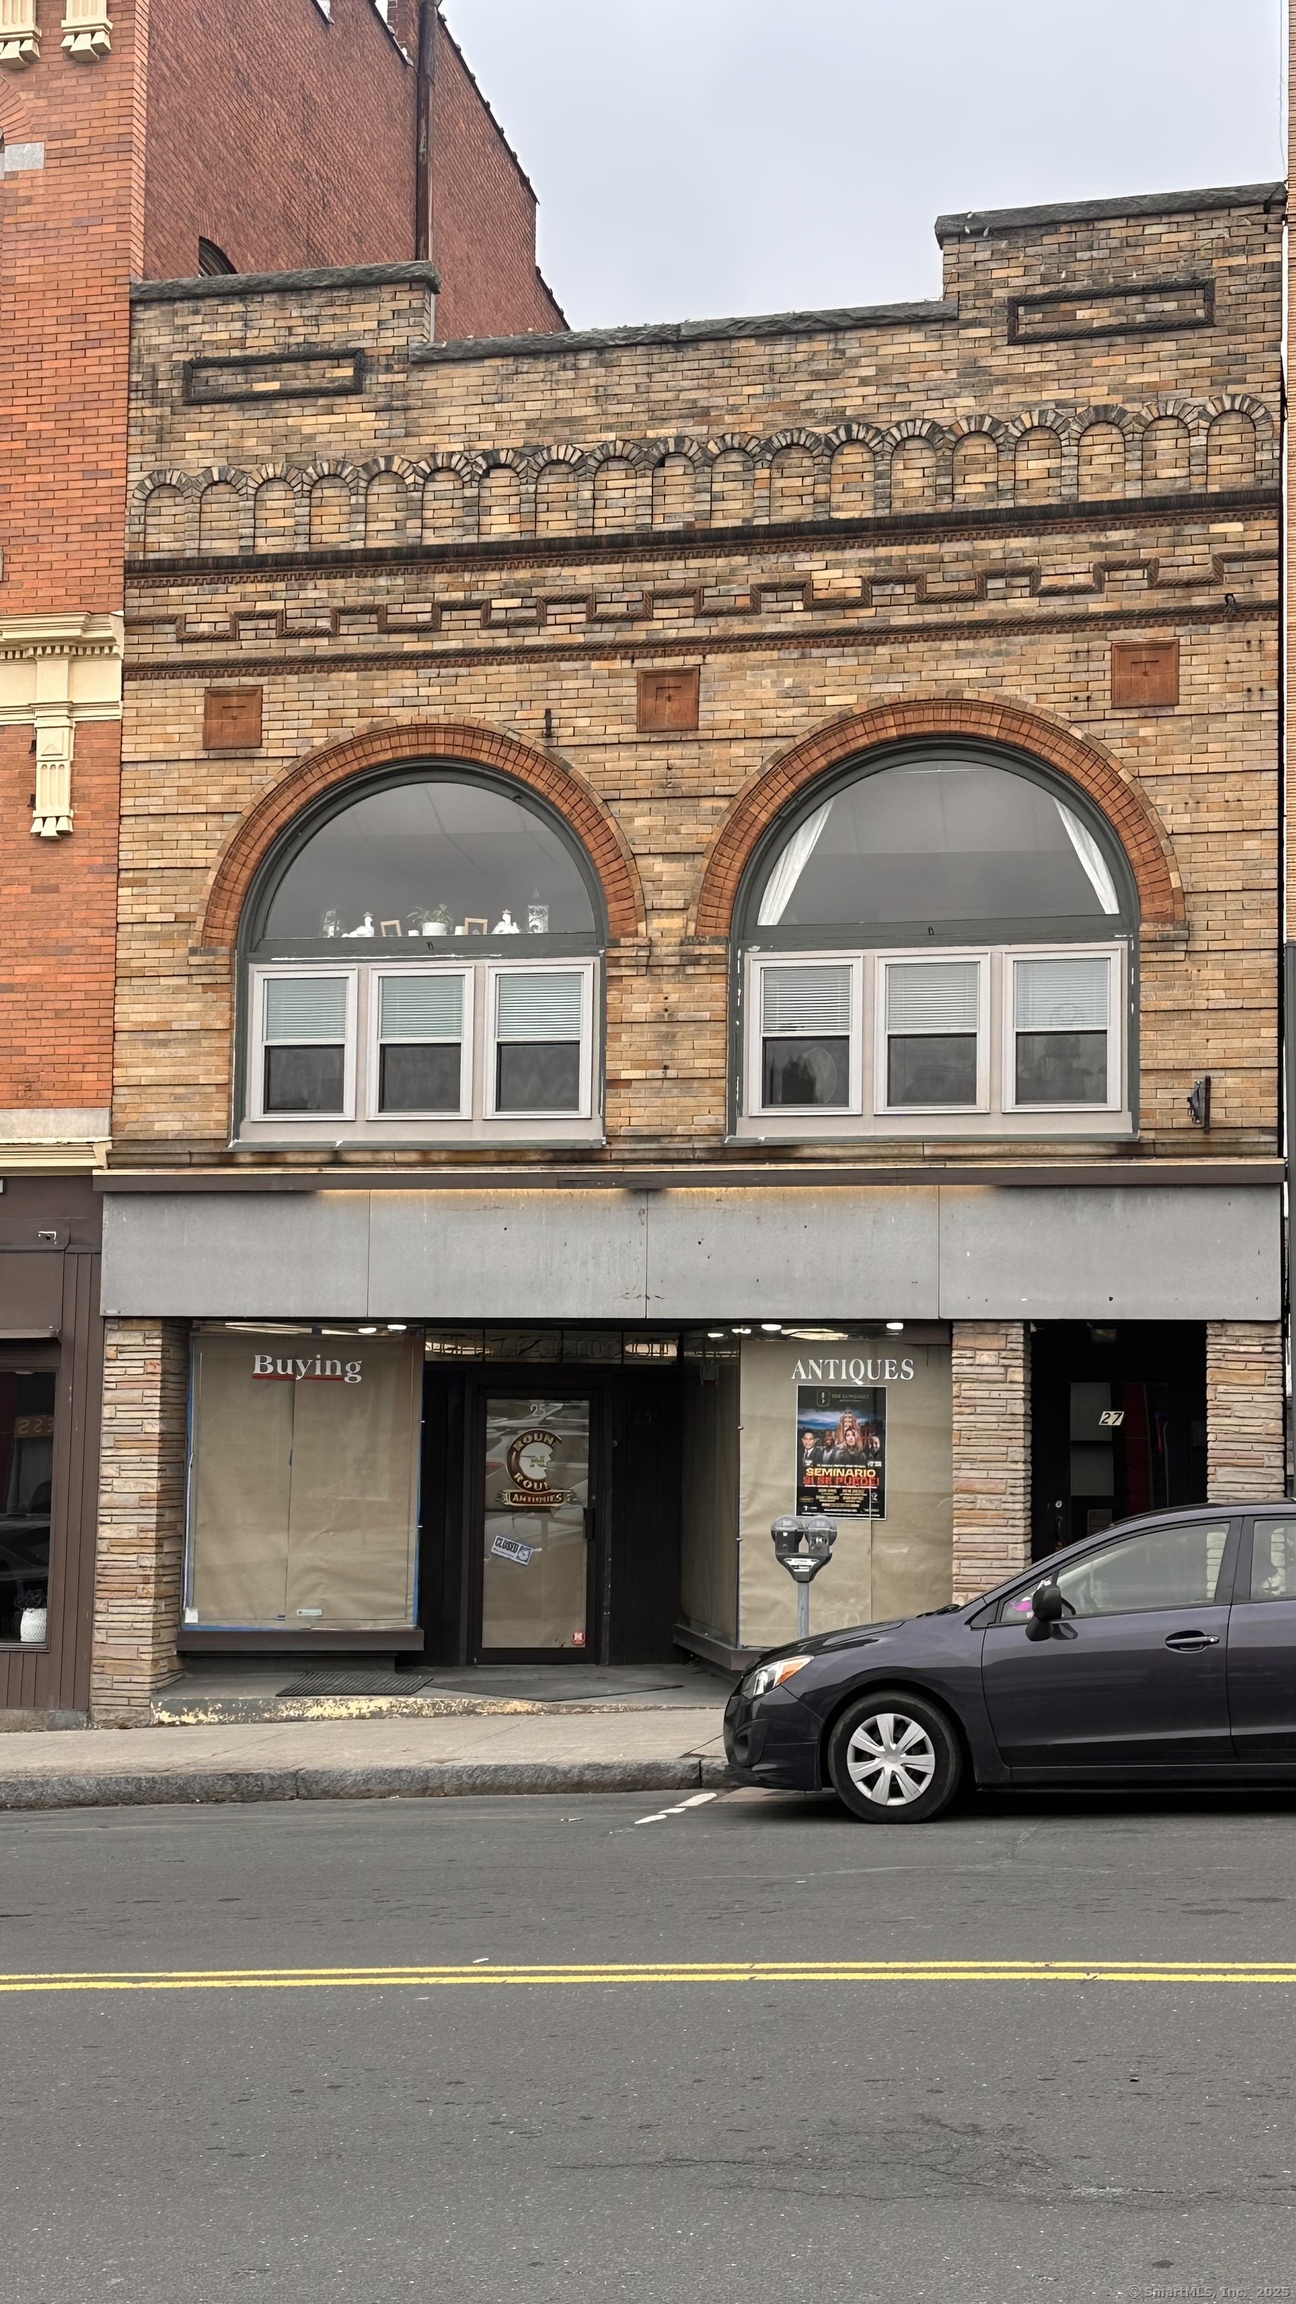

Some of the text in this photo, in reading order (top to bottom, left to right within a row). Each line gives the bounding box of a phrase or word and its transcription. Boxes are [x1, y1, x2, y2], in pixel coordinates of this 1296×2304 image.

[252, 1354, 362, 1384] Buying
[791, 1358, 914, 1385] ANTIQUES
[530, 1403, 546, 1418] 25
[1101, 1412, 1122, 1425] 27
[806, 1467, 876, 1478] SEMINARIO
